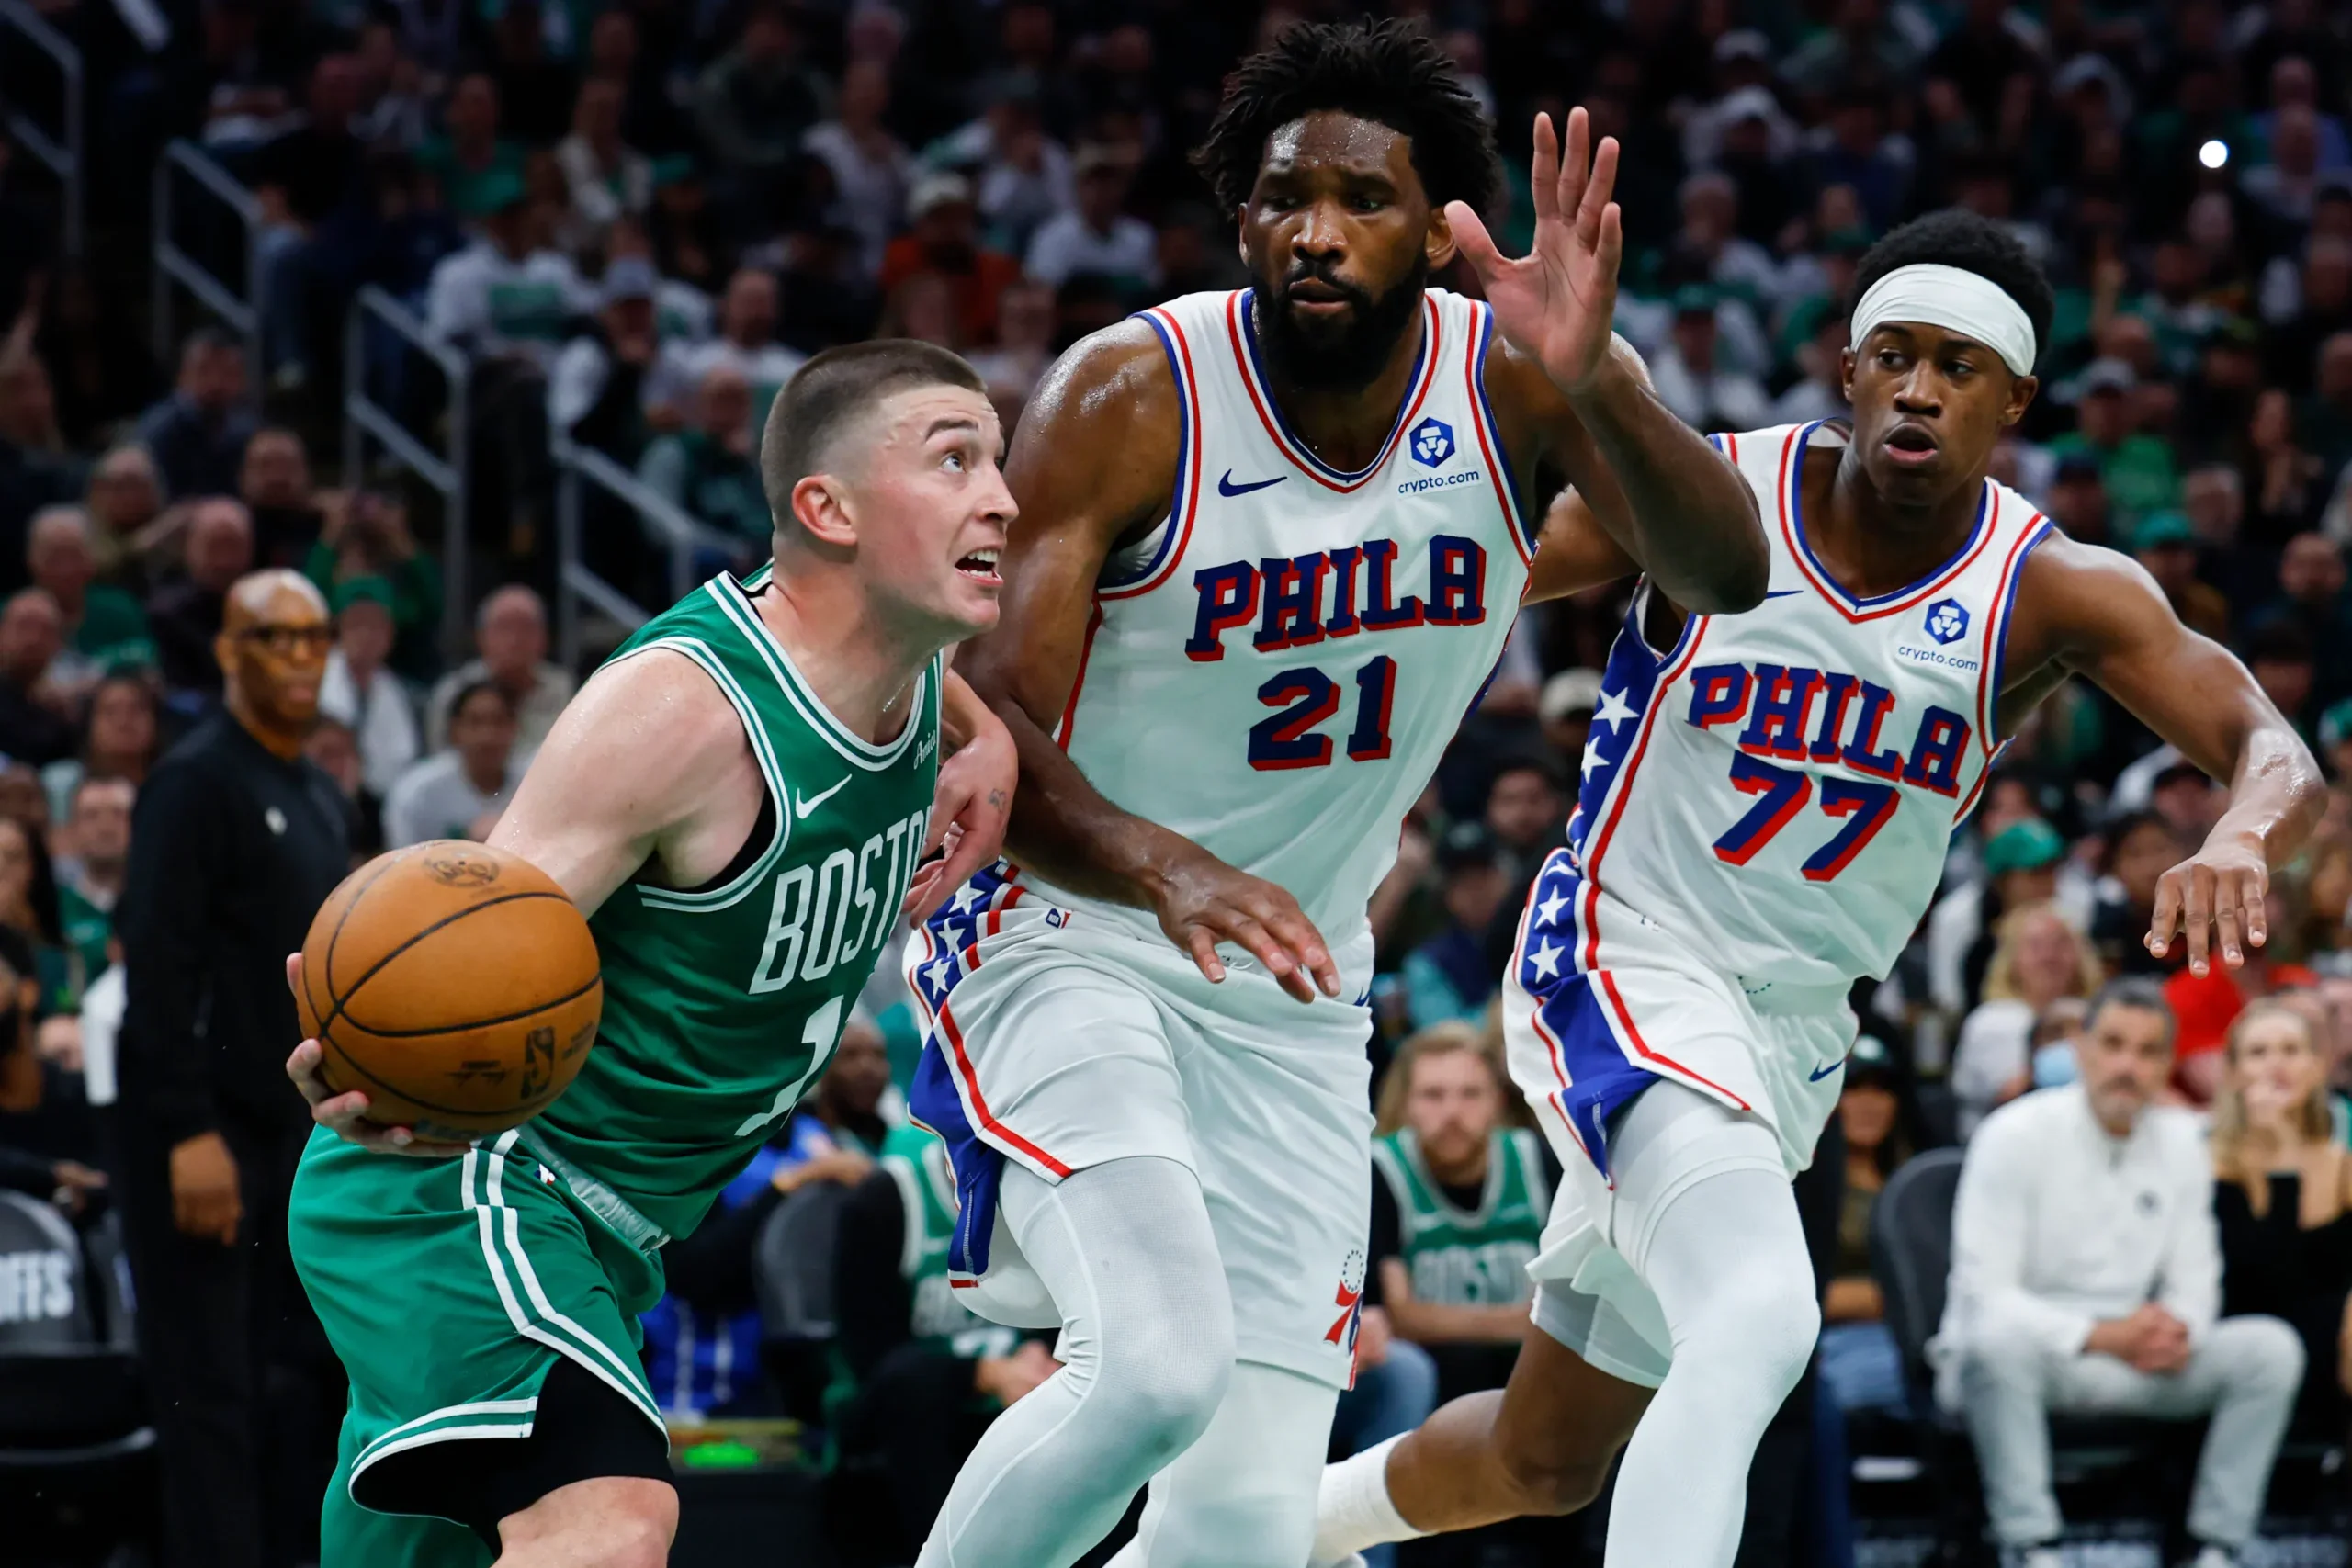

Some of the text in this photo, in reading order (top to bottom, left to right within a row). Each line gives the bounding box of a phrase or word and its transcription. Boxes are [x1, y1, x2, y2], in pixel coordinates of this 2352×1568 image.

[1398, 469, 1479, 494] crypto.com
[1185, 535, 1486, 661] PHILA
[1898, 645, 1978, 671] crypto.com
[1248, 655, 1396, 771] 21
[1684, 662, 1972, 799] PHILA
[1712, 750, 1901, 882] 77
[749, 805, 933, 995] BOSTO
[0, 1250, 74, 1321] FFS
